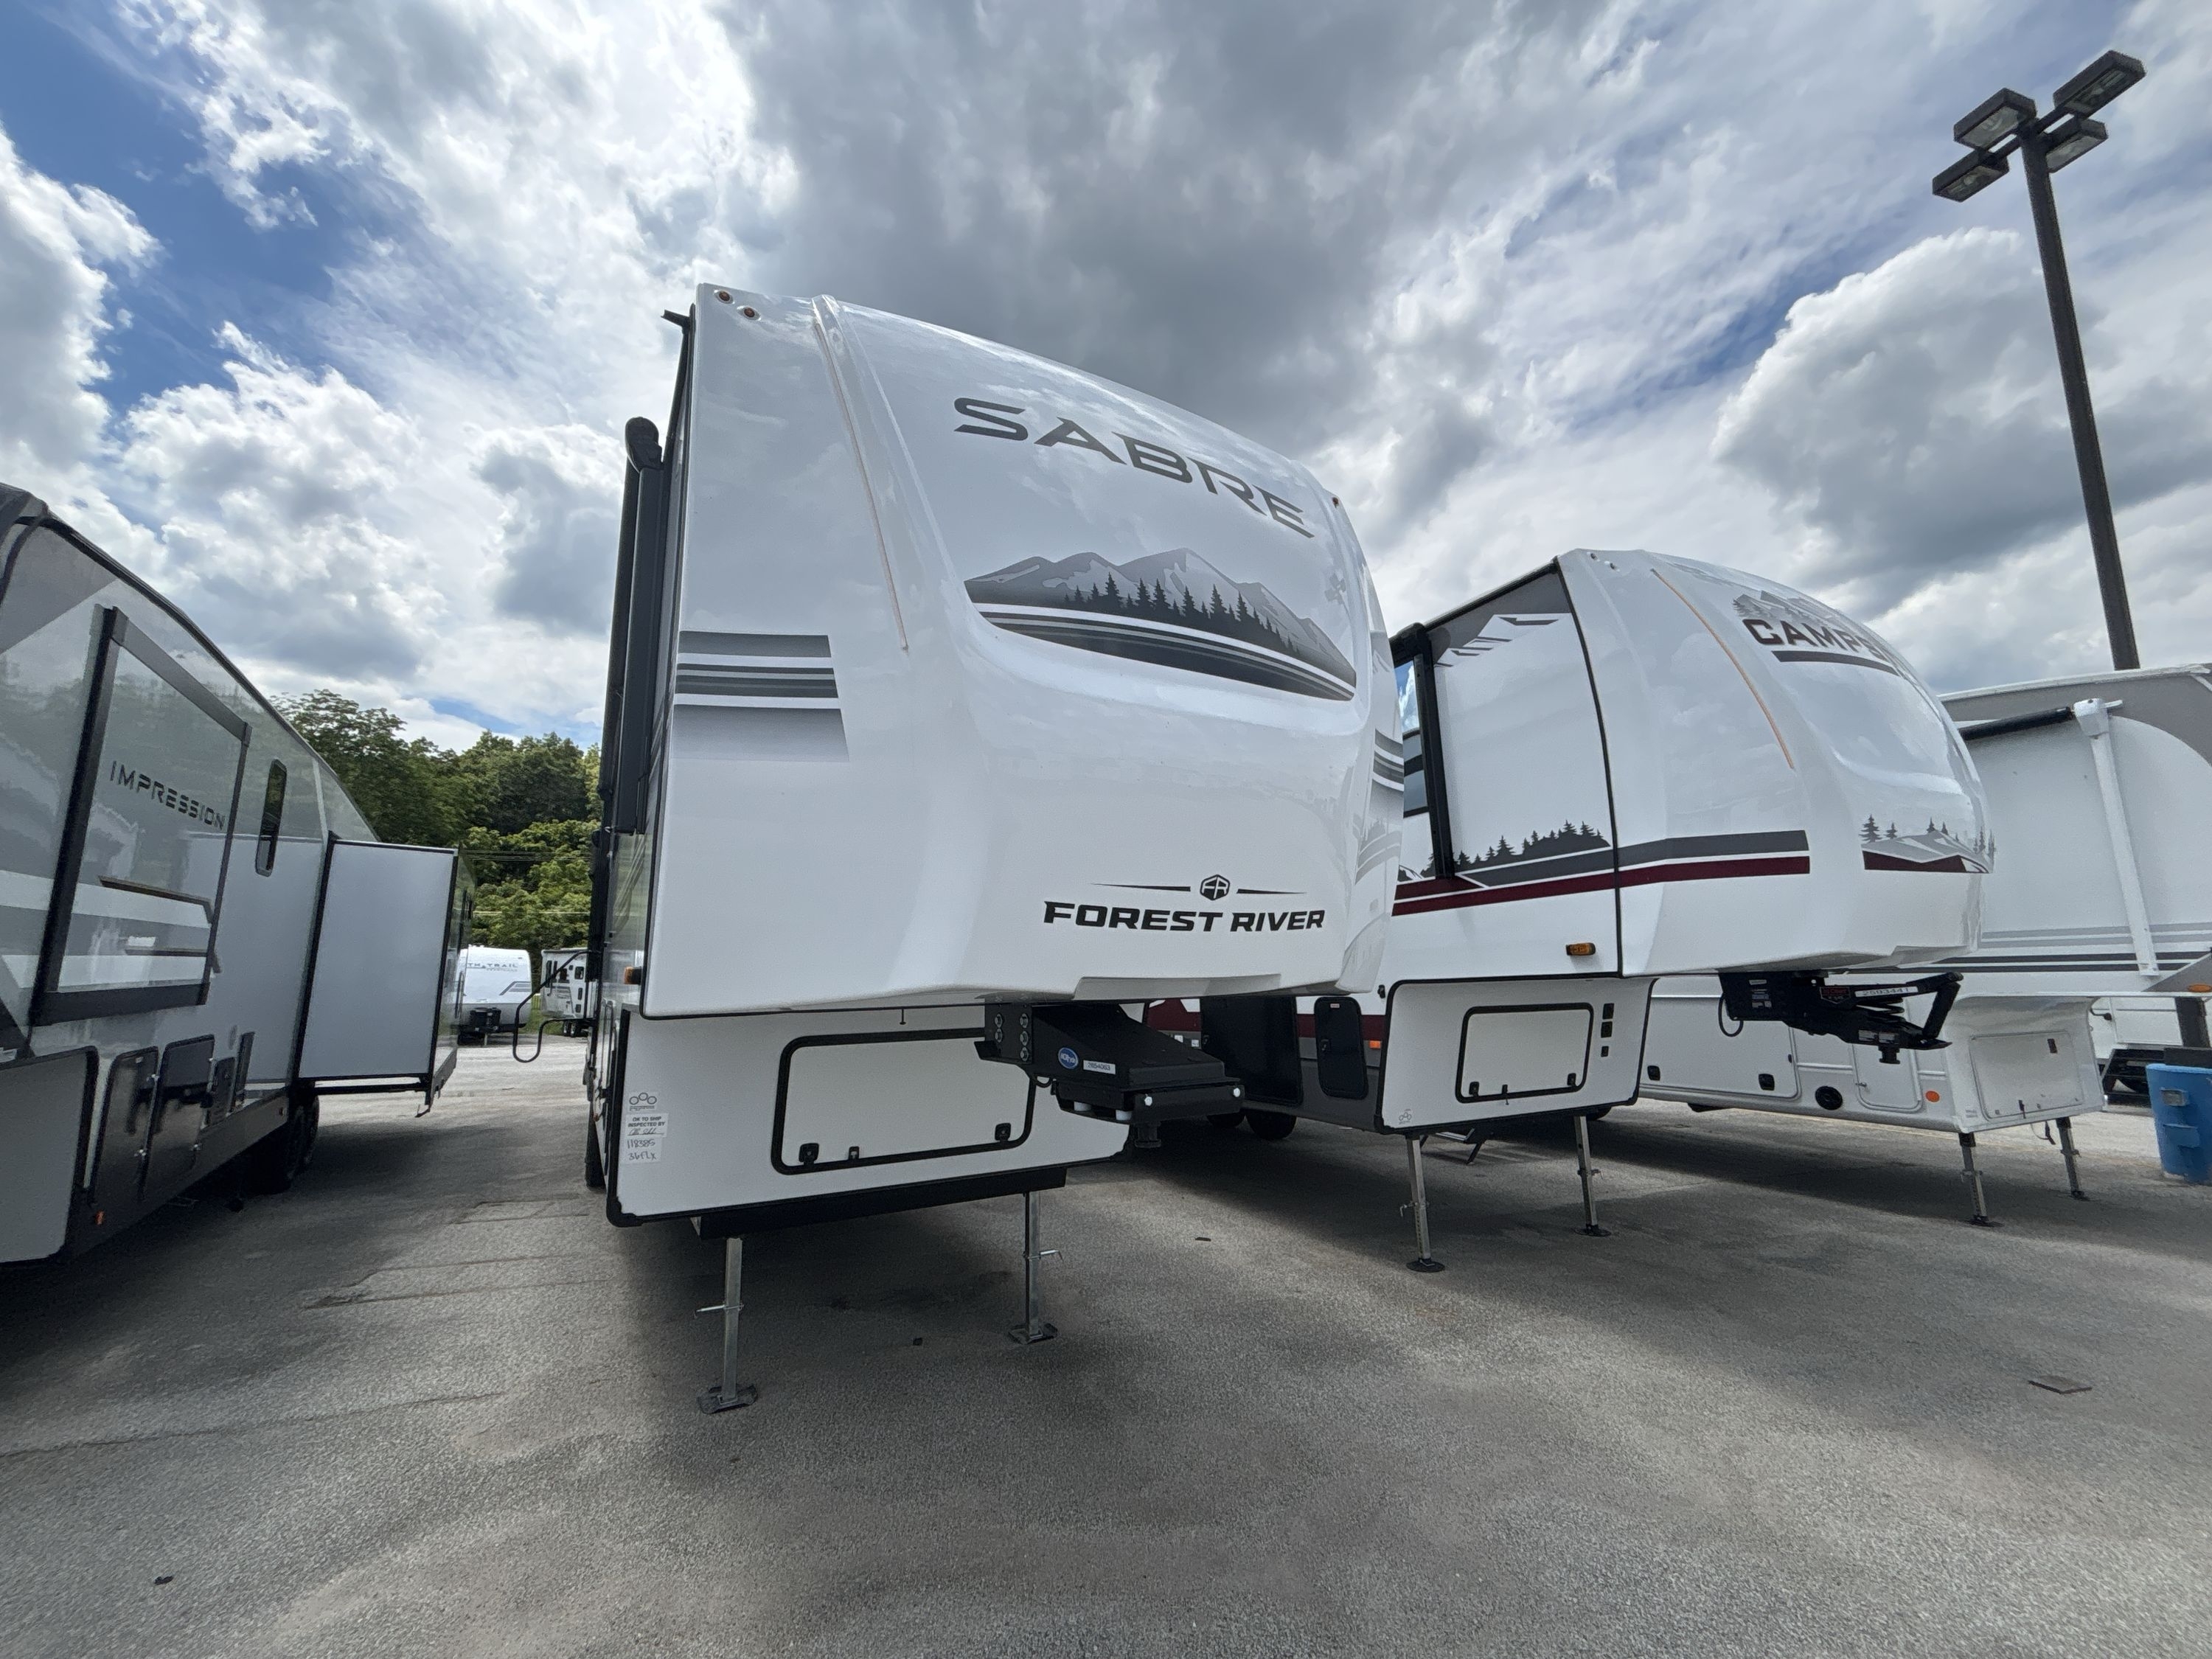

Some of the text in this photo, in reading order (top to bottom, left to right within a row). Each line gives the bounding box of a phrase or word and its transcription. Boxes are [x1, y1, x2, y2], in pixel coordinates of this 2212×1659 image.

[953, 397, 1315, 538] SABRE
[1742, 619, 1895, 667] CAMPS
[110, 760, 226, 830] IMPRESSION
[1043, 900, 1326, 932] FOREST RIVER
